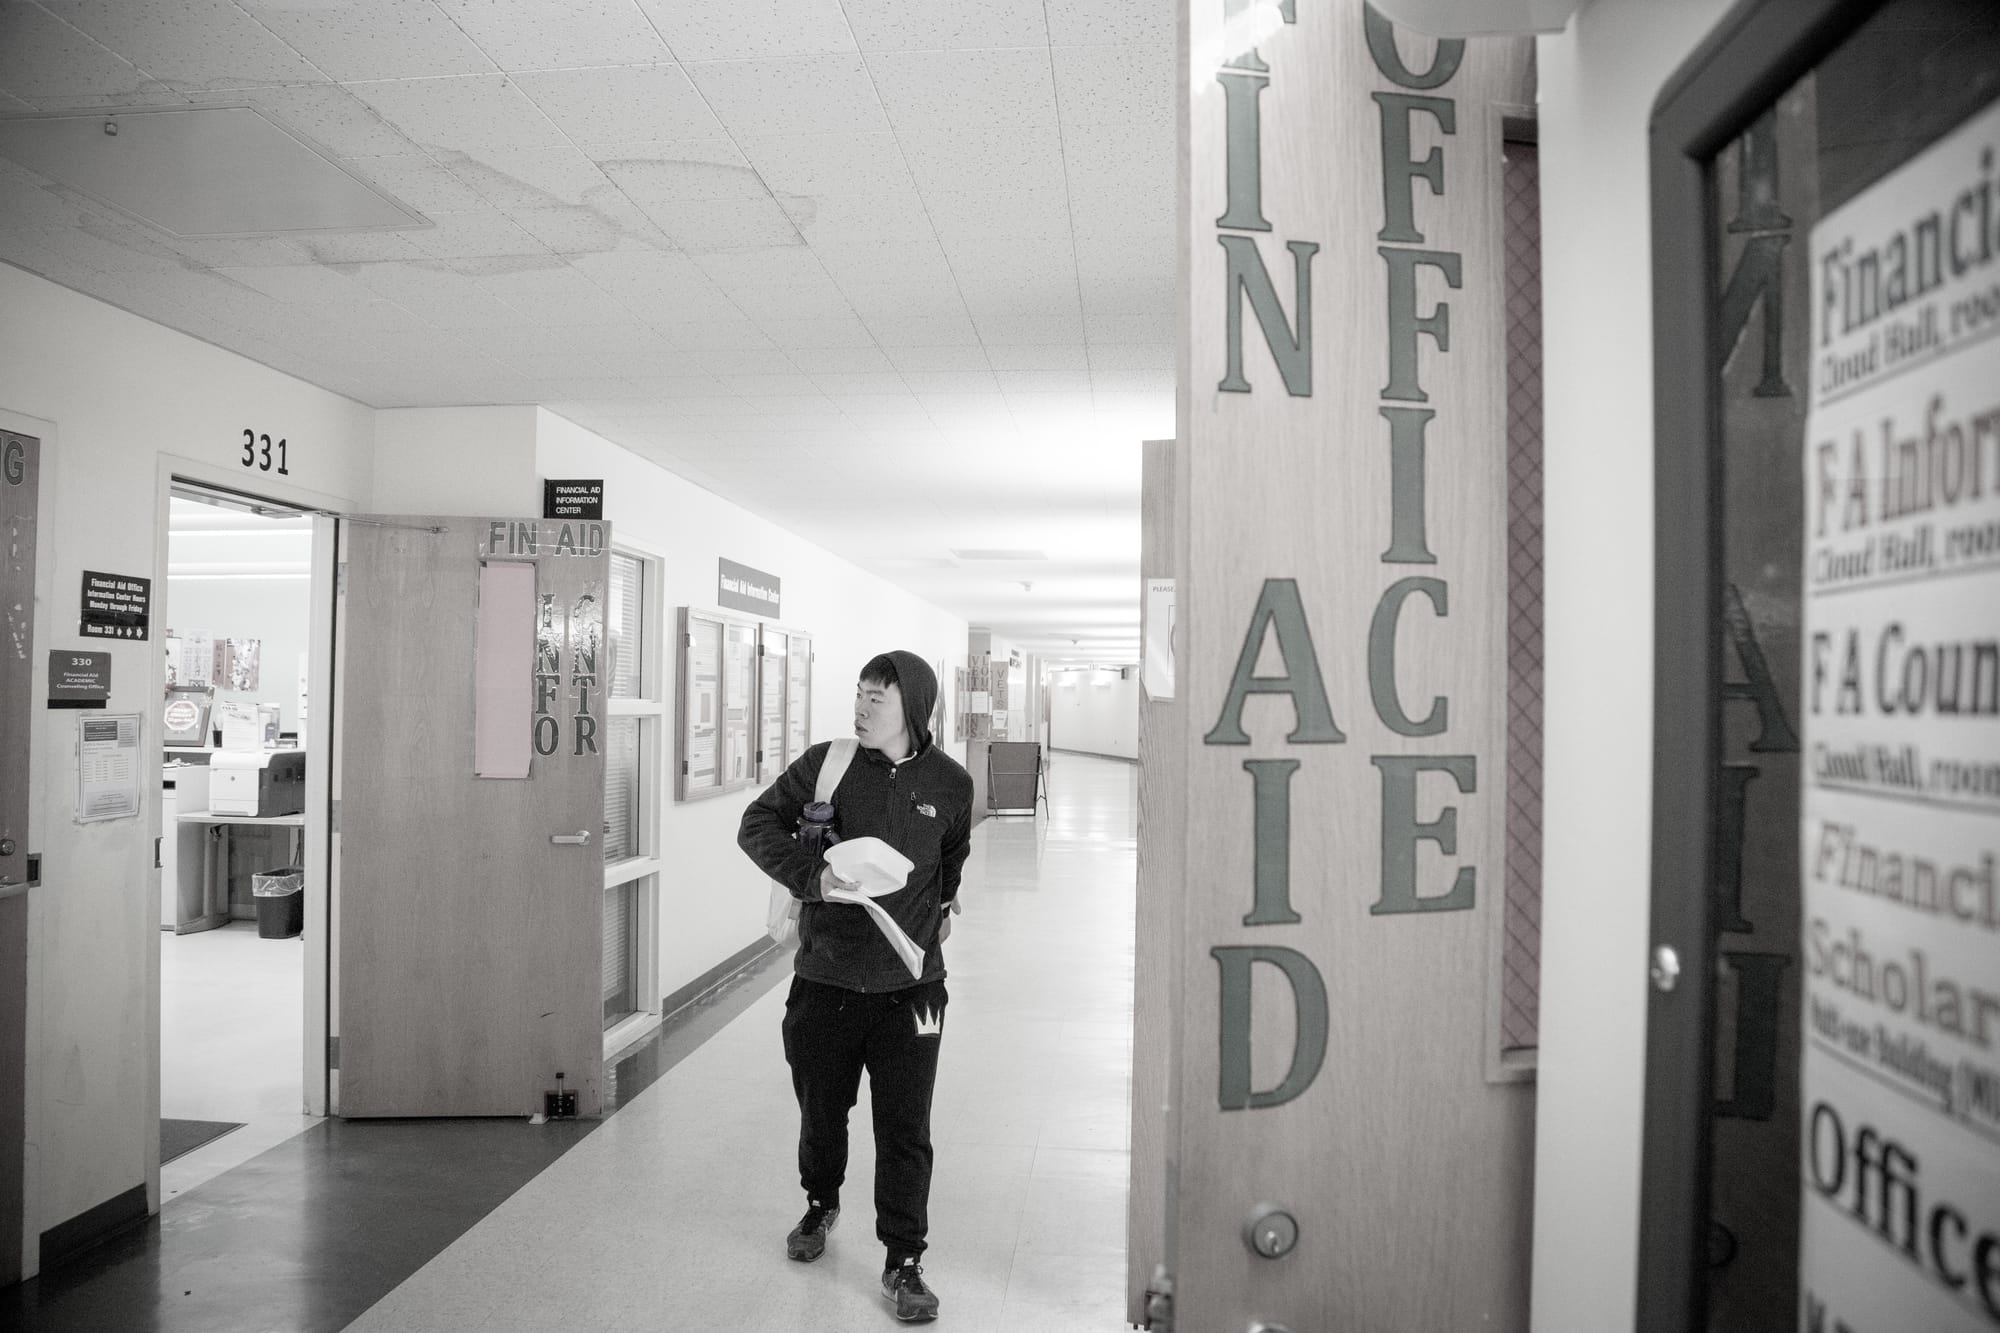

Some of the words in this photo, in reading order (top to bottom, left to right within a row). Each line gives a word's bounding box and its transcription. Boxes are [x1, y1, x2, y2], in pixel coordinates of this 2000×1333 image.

[1822, 145, 2000, 346] Financi
[242, 428, 289, 475] 331
[1842, 428, 1867, 531] A
[1880, 393, 2000, 522] Infor
[556, 486, 589, 494] FINANCIAL
[590, 486, 601, 494] AID
[555, 496, 598, 504] INFORMATION
[555, 506, 581, 514] CENTER
[489, 521, 537, 555] FIN
[554, 523, 603, 556] AID
[91, 577, 116, 589] Financial
[117, 581, 127, 590] Aid
[127, 582, 144, 592] Office
[87, 589, 115, 599] Information
[116, 592, 131, 601] Center
[90, 600, 108, 611] Monday
[109, 602, 127, 612] through
[128, 604, 143, 613] Friday
[87, 624, 103, 634] Room
[104, 625, 114, 635] 331
[71, 657, 92, 666] 330
[1812, 631, 1831, 715] F
[1837, 627, 1863, 715] A
[1204, 577, 1347, 1112] AID
